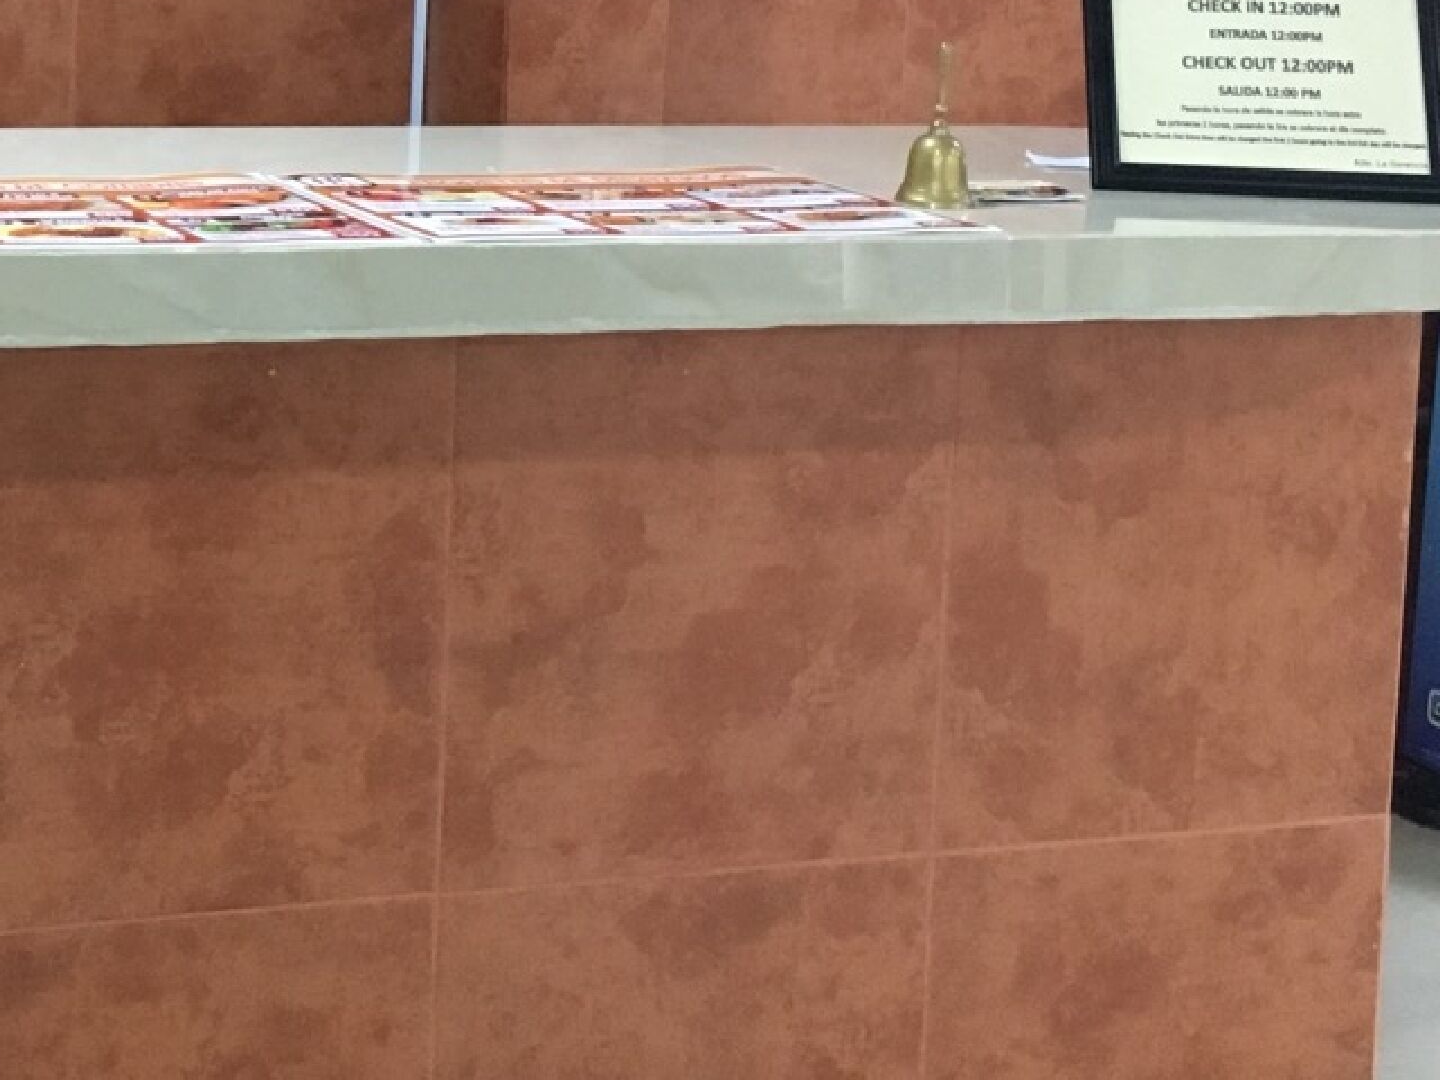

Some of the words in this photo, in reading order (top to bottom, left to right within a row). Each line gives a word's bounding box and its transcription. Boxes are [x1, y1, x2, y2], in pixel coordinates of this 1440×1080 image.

[1188, 0, 1240, 13] CHECK
[1247, 1, 1264, 13] IN
[1269, 2, 1340, 17] 12:00PM
[1210, 29, 1267, 40] ENTRADA
[1182, 56, 1236, 69] CHECK
[1240, 57, 1275, 70] OUT
[1282, 59, 1354, 74] 12:00PM
[1218, 85, 1260, 96] SALIDA
[1301, 88, 1321, 99] PM
